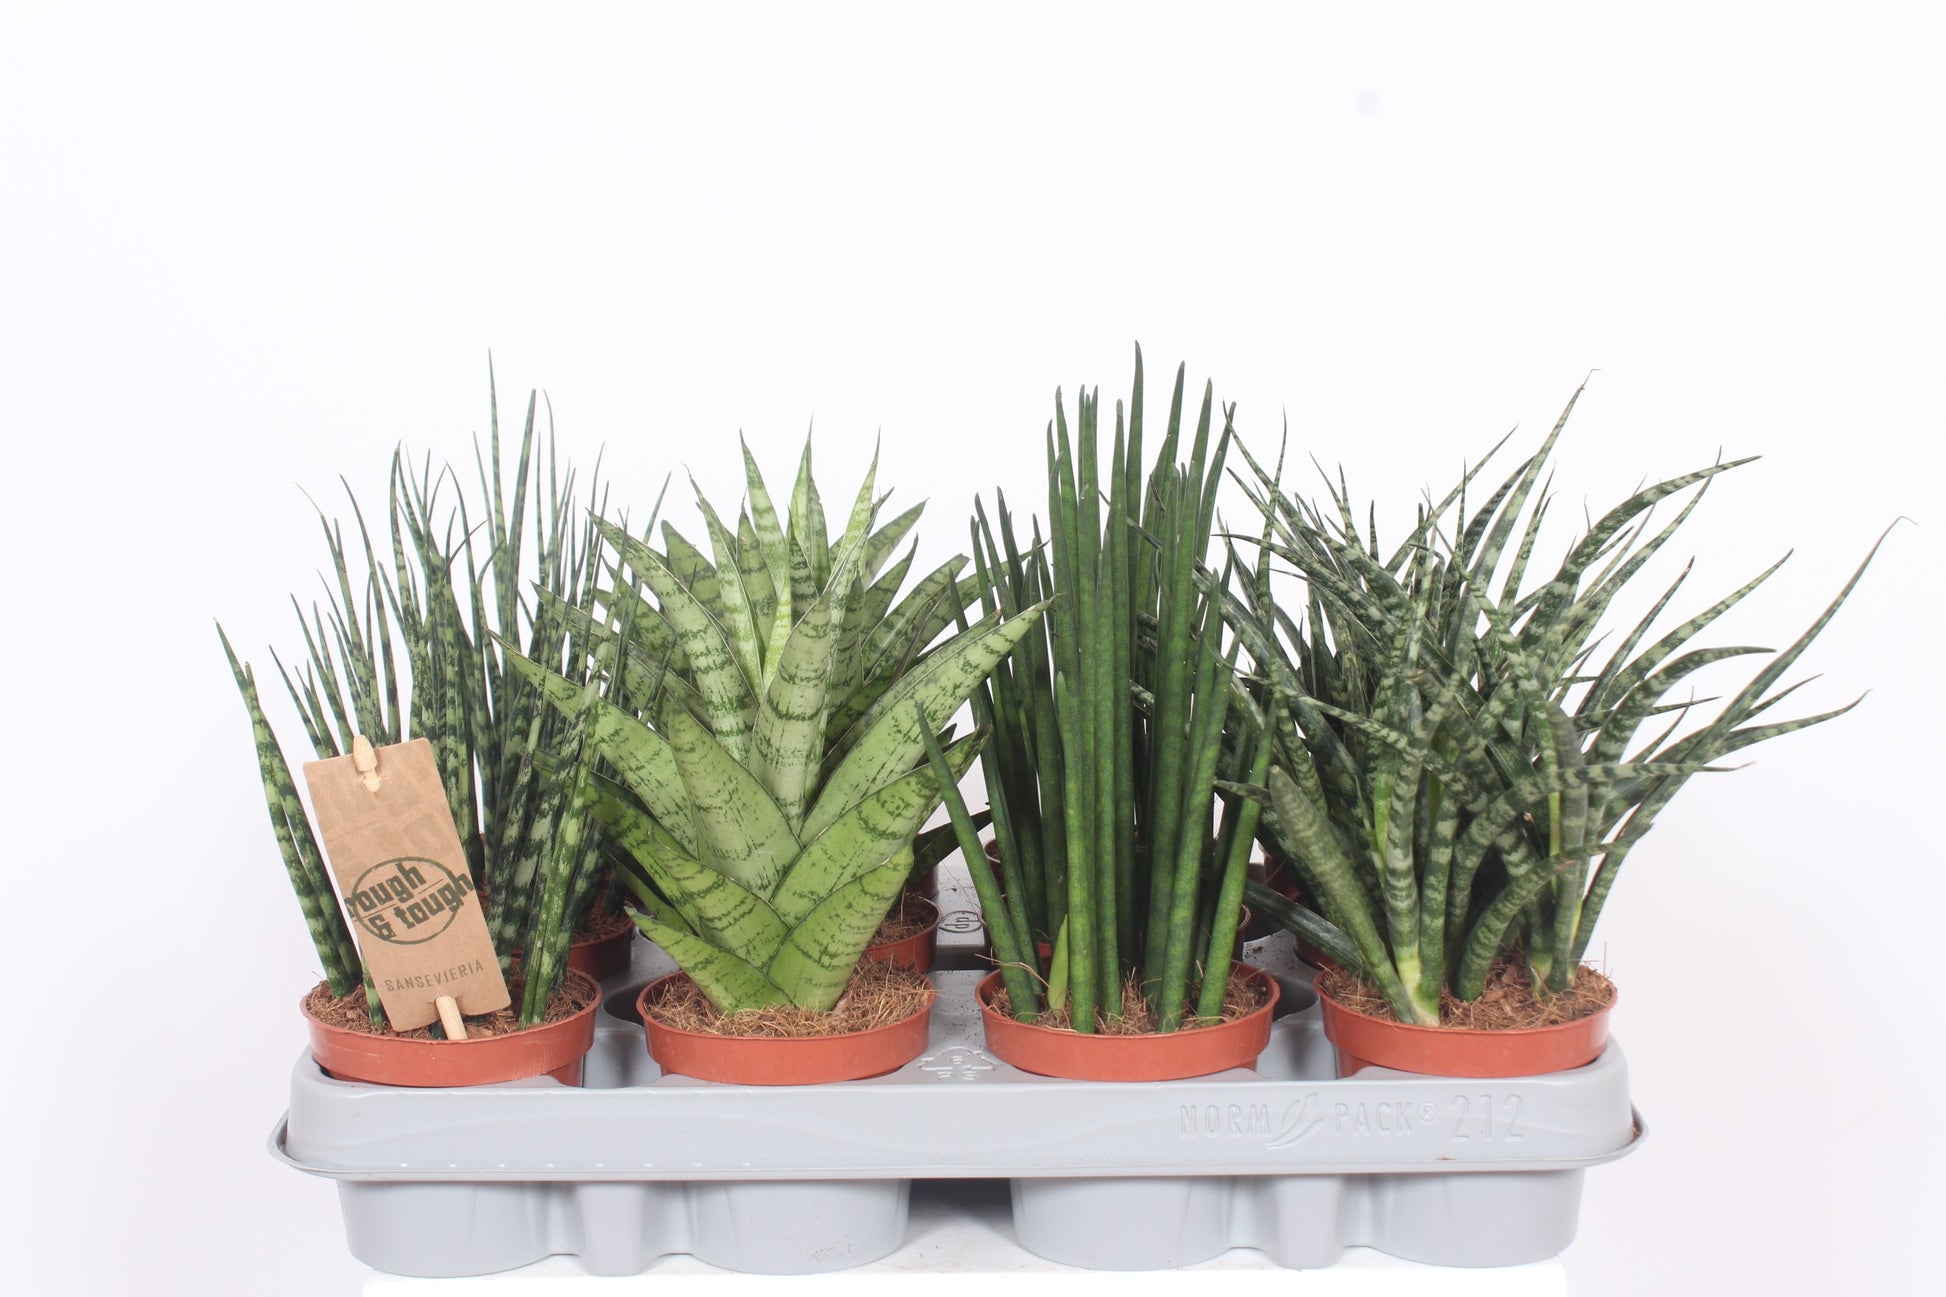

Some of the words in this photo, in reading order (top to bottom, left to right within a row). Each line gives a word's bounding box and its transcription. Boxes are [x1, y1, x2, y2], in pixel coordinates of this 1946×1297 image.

[393, 873, 475, 929] tough
[384, 959, 484, 992] SANSEVIERIA
[1180, 1103, 1272, 1138] NORM
[1449, 1094, 1525, 1142] 212
